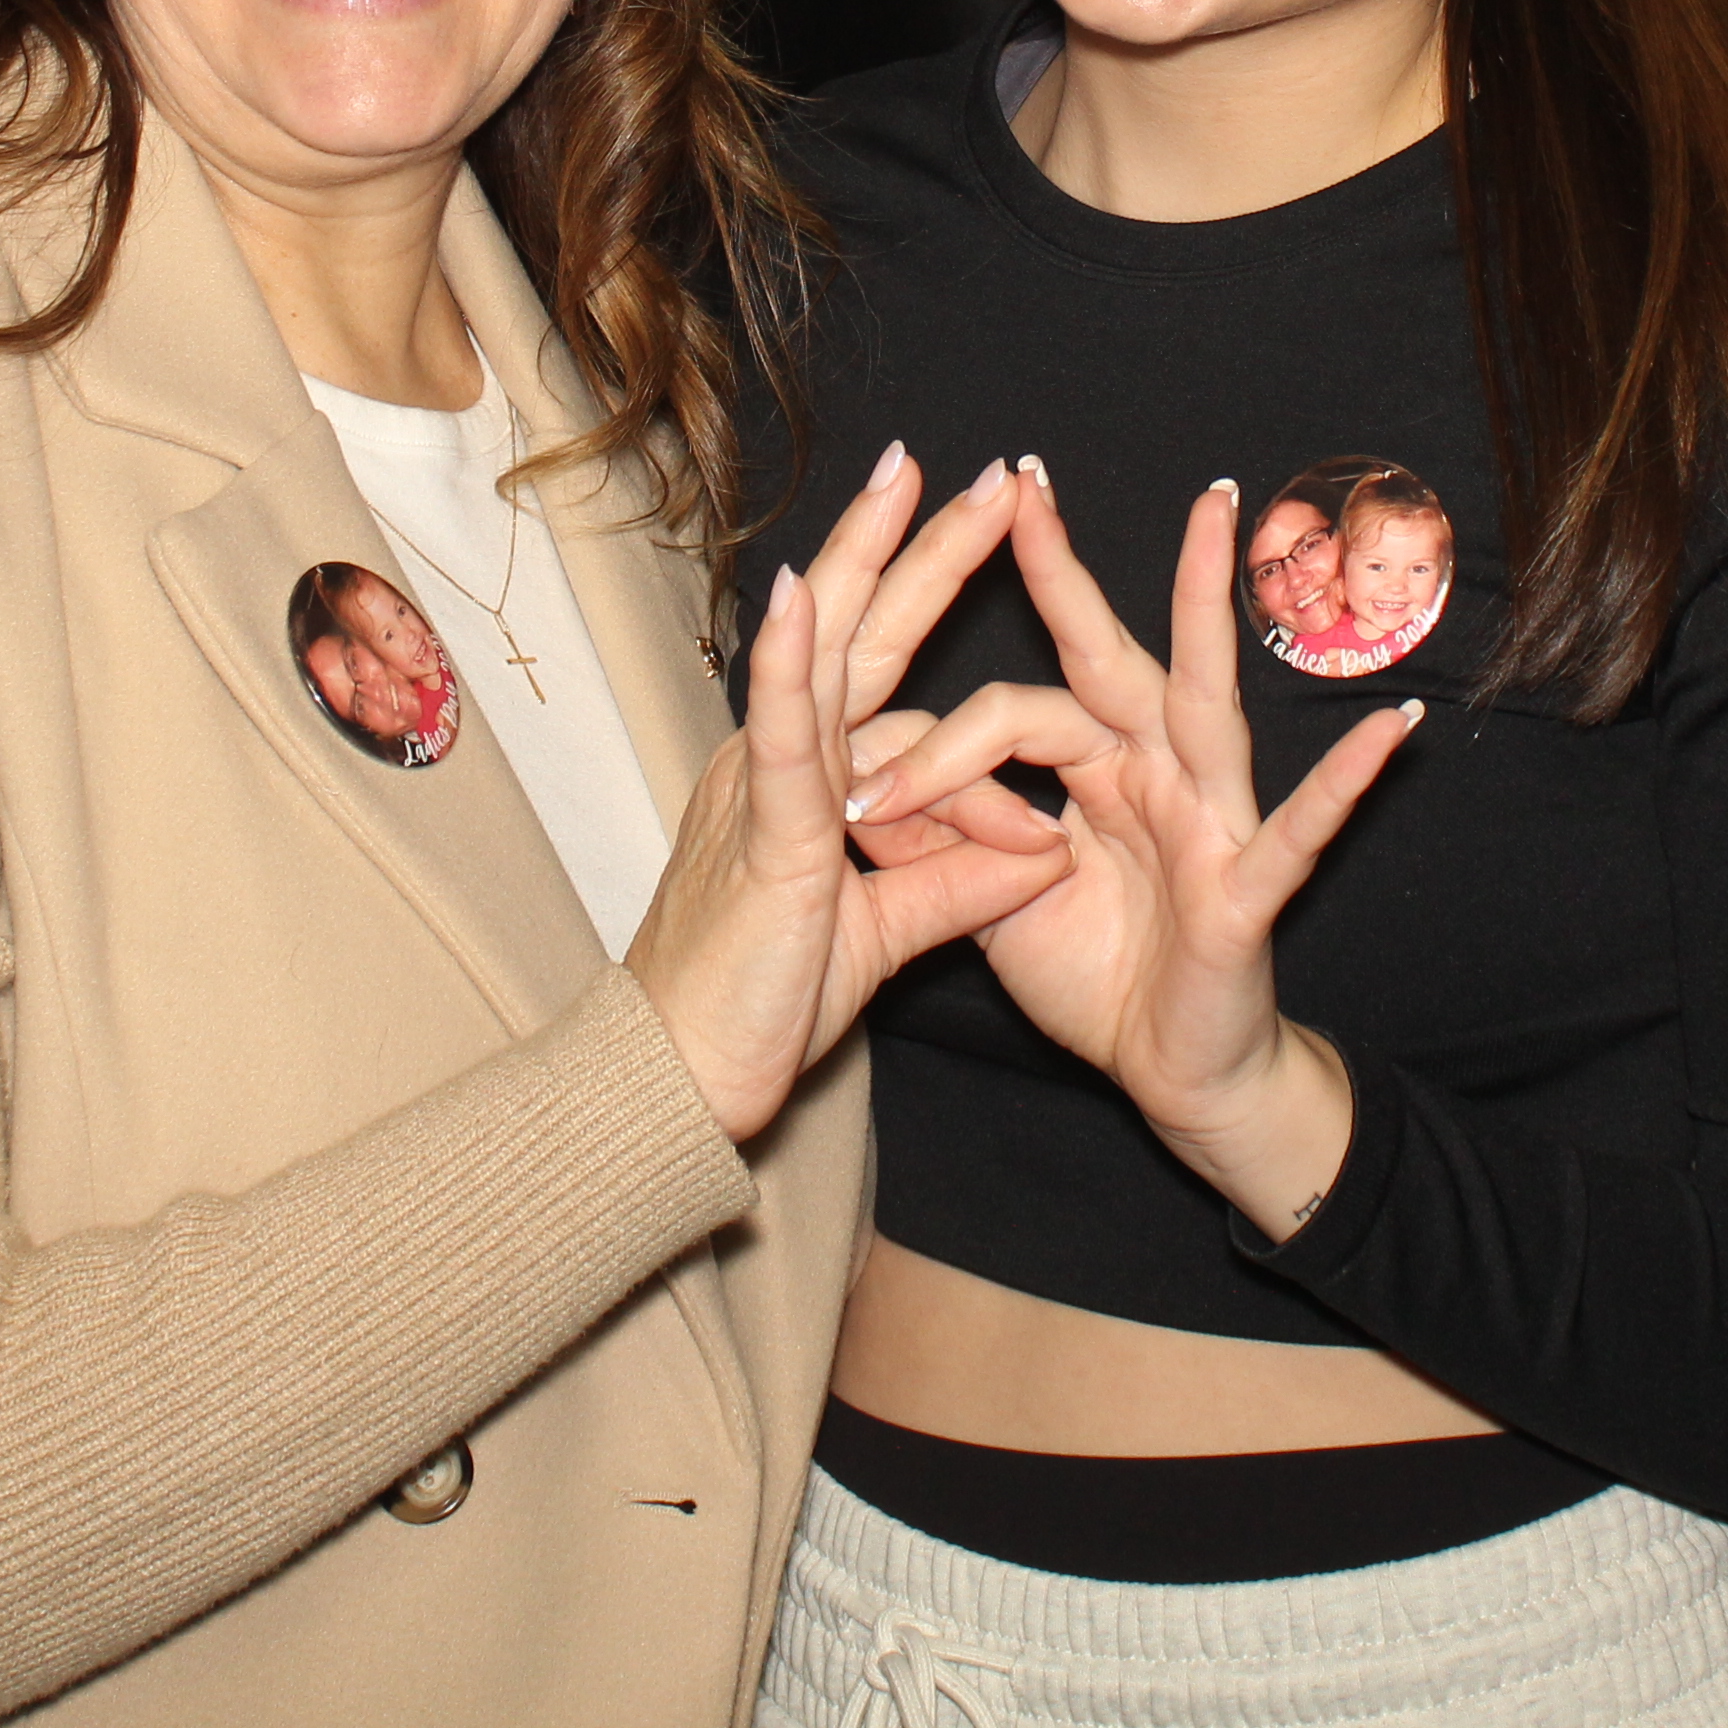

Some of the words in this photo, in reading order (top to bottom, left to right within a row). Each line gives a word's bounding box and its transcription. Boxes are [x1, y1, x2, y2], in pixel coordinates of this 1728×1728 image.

[1262, 627, 1330, 676] Ladies
[1339, 643, 1393, 677] Day
[403, 724, 451, 768] Ladies
[439, 681, 460, 729] Day
